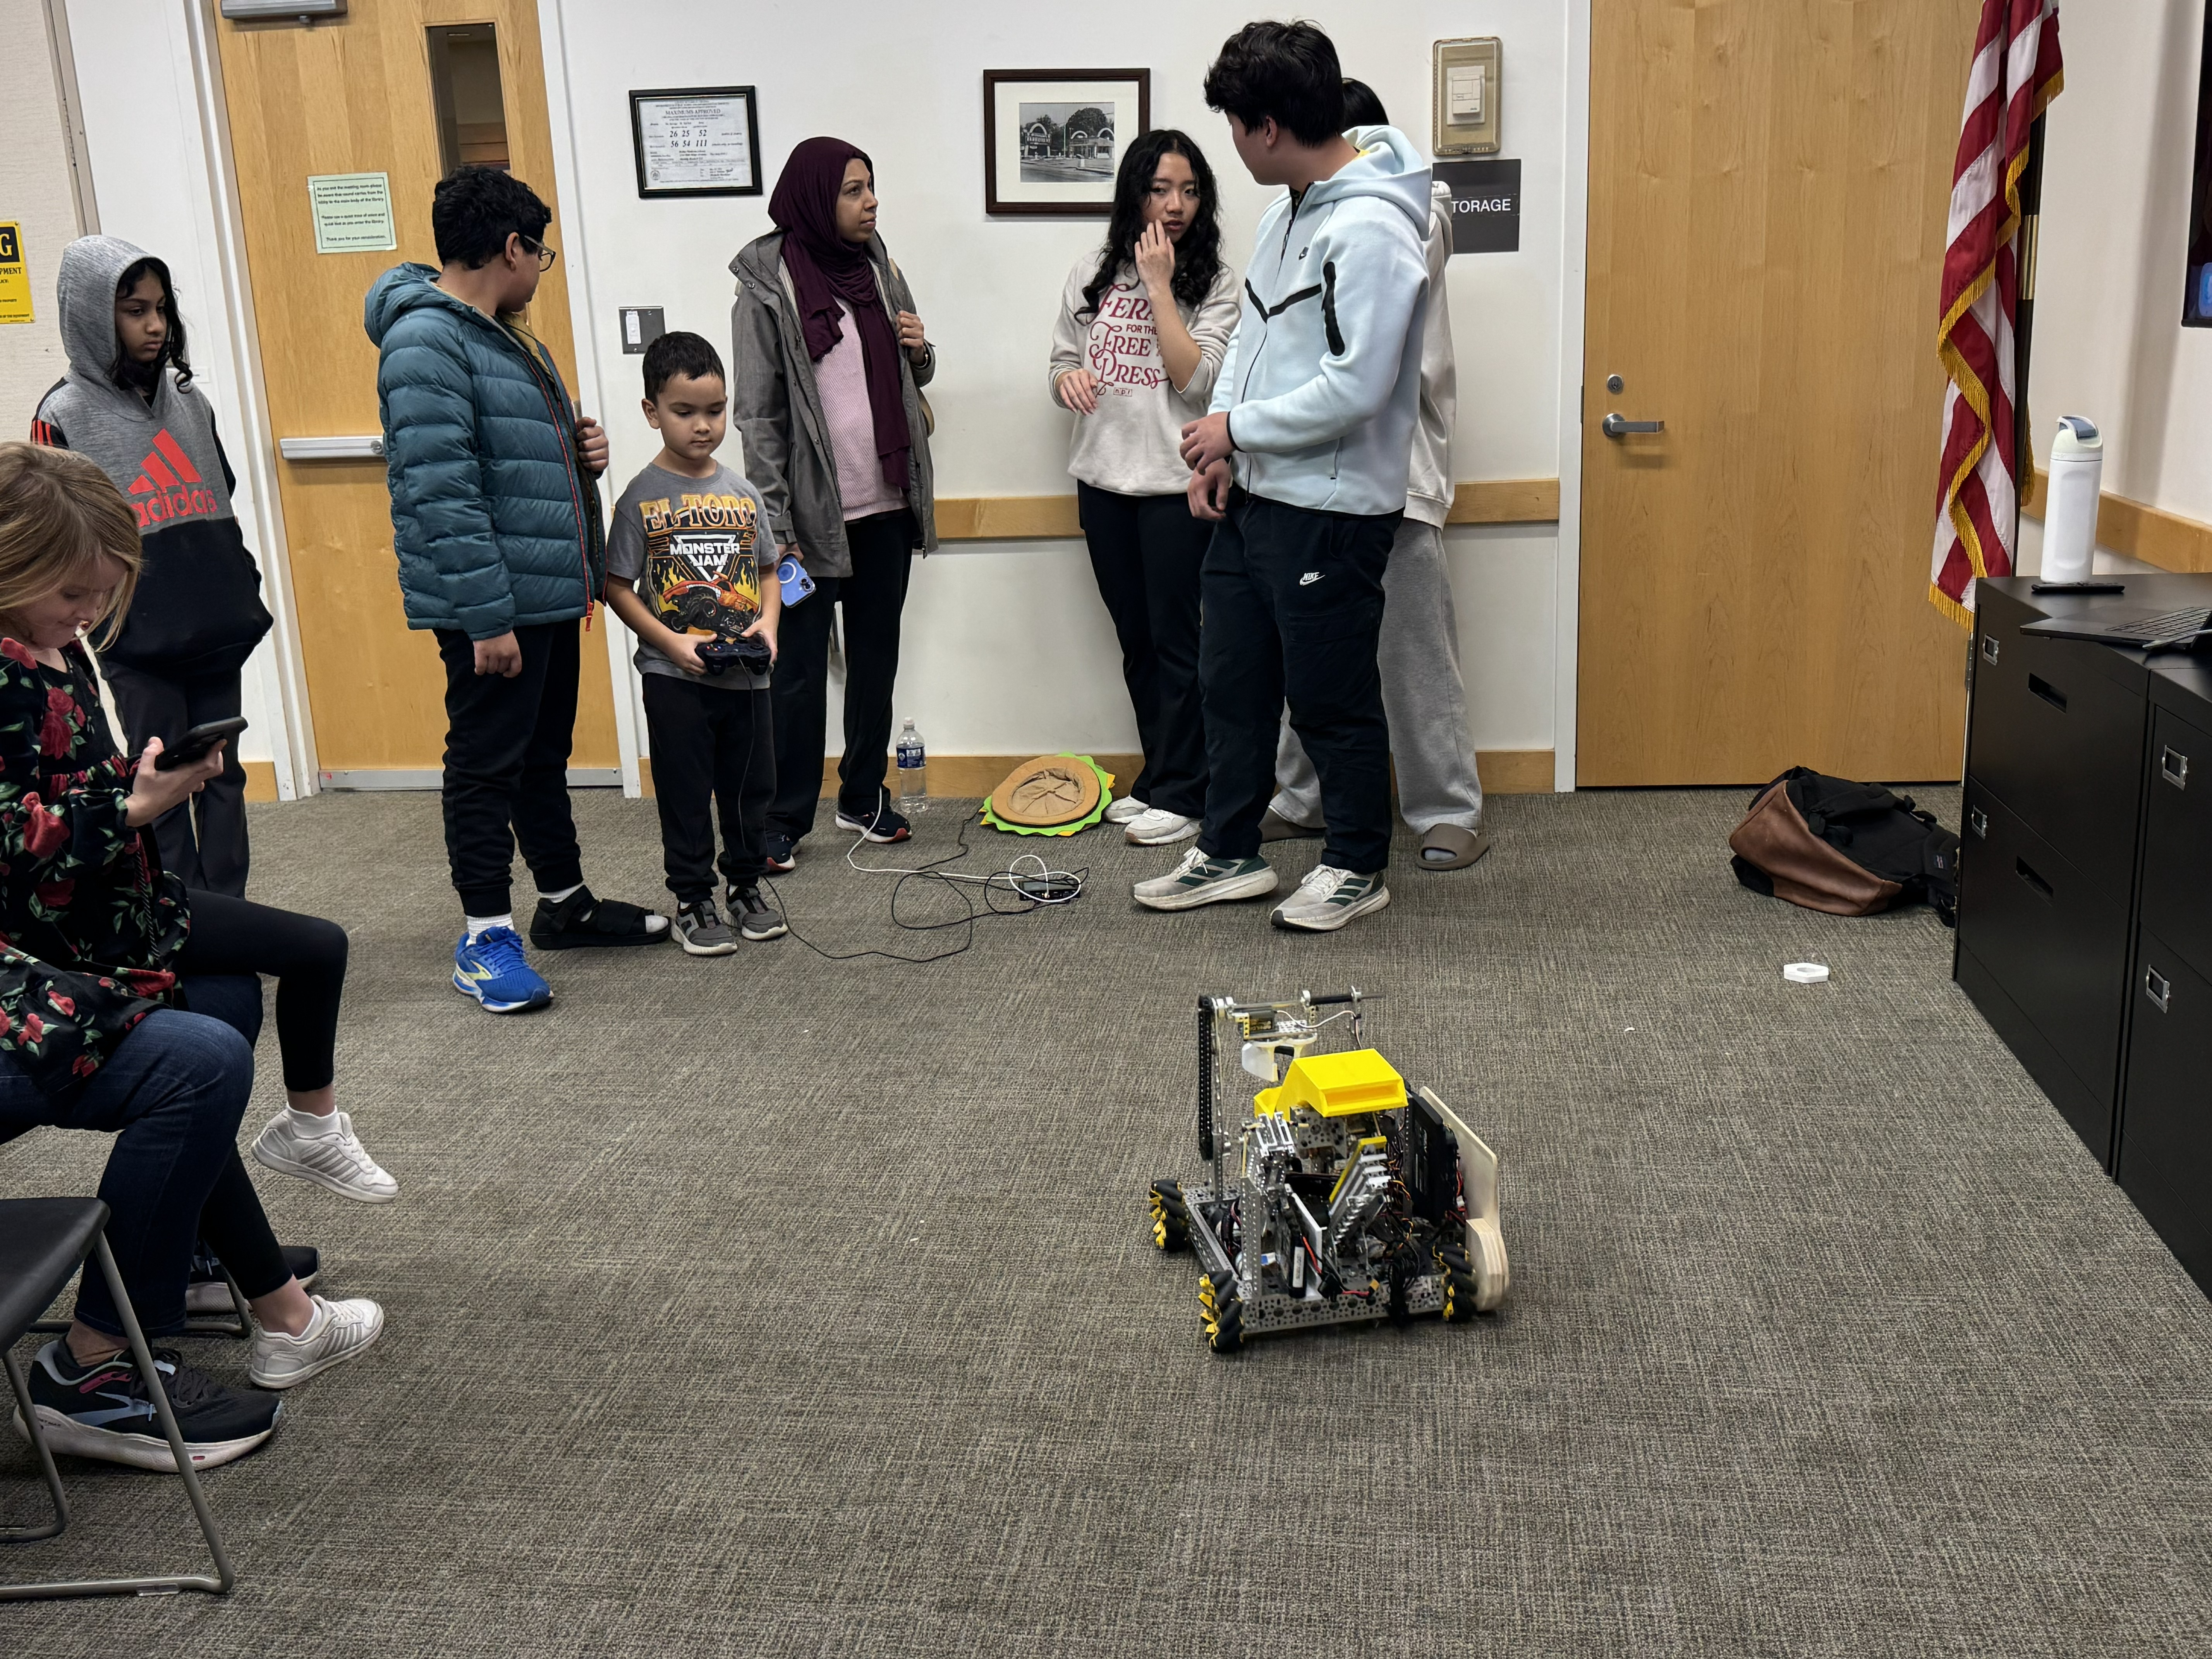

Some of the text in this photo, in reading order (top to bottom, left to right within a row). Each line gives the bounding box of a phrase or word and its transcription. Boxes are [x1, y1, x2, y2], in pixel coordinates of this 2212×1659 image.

[1451, 199, 1511, 213] TORAGE
[0, 267, 22, 275] PMENT
[1126, 324, 1142, 333] FOR
[1090, 322, 1151, 359] FREE
[1089, 345, 1170, 391] PRESS
[131, 485, 217, 528] adidas
[639, 493, 757, 533] EL TORO
[670, 543, 740, 555] MONSTER
[688, 554, 728, 567] JAM
[1303, 572, 1320, 581] NIKE
